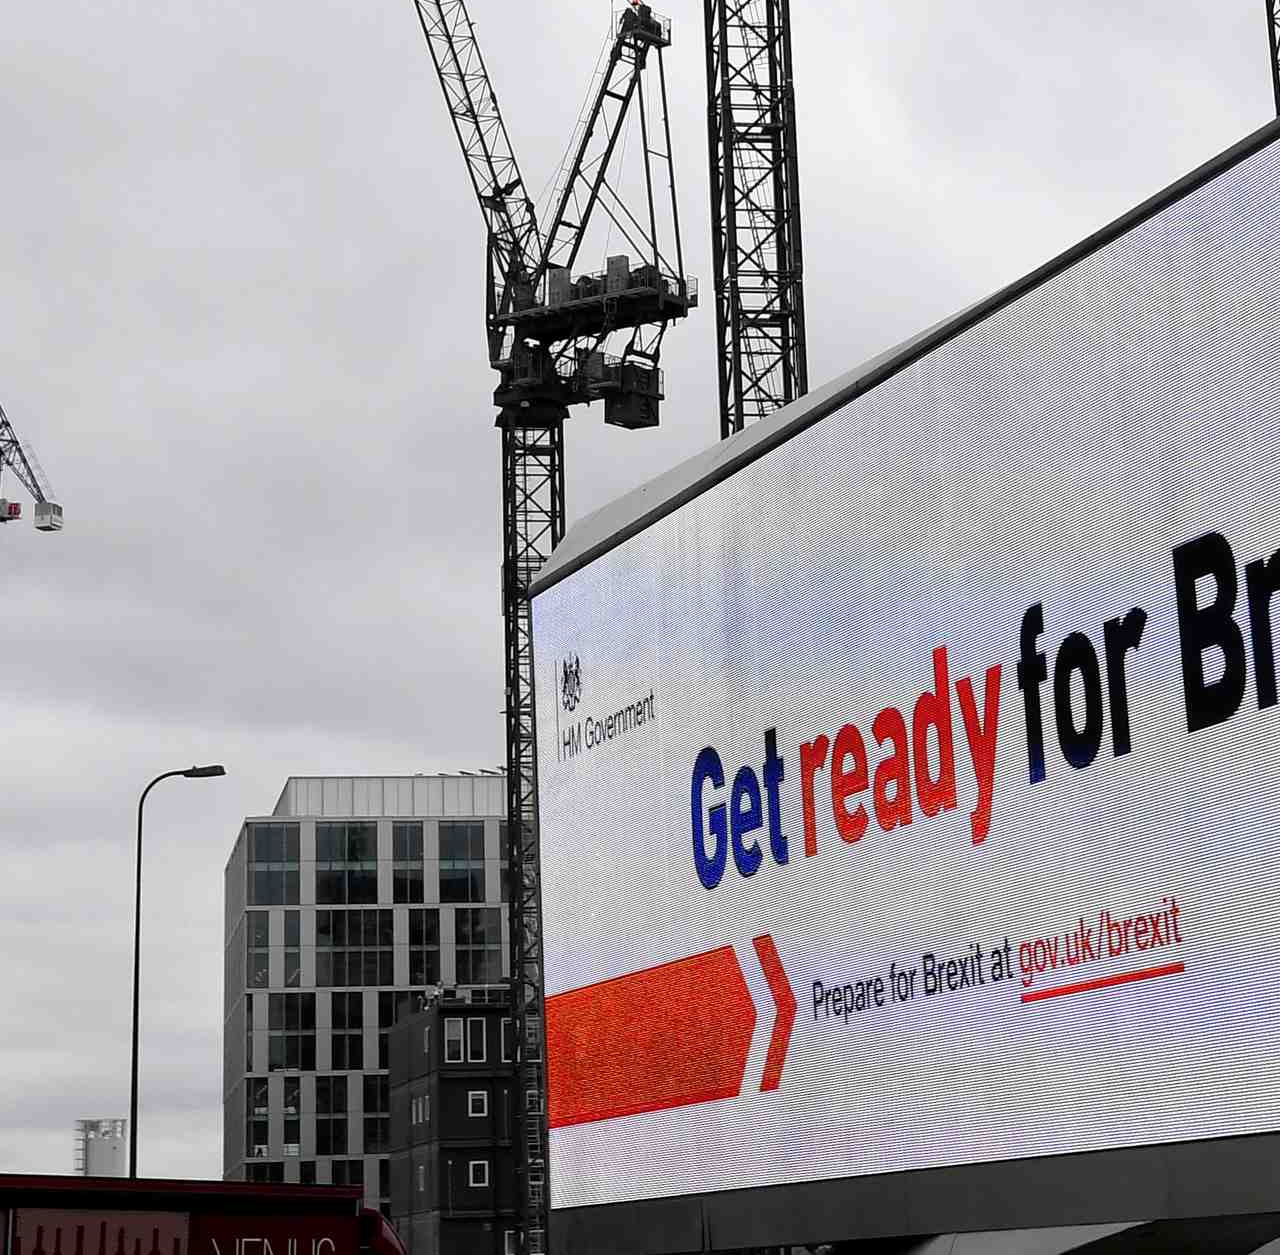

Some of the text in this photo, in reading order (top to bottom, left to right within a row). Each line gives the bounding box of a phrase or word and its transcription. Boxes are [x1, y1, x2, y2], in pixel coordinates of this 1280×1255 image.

[562, 687, 656, 762] HM Government
[691, 727, 790, 891] Get
[799, 645, 1003, 857] ready
[1017, 601, 1148, 785] for
[811, 895, 1183, 1026] Prepare for Brexit at gov.uk/brexit
